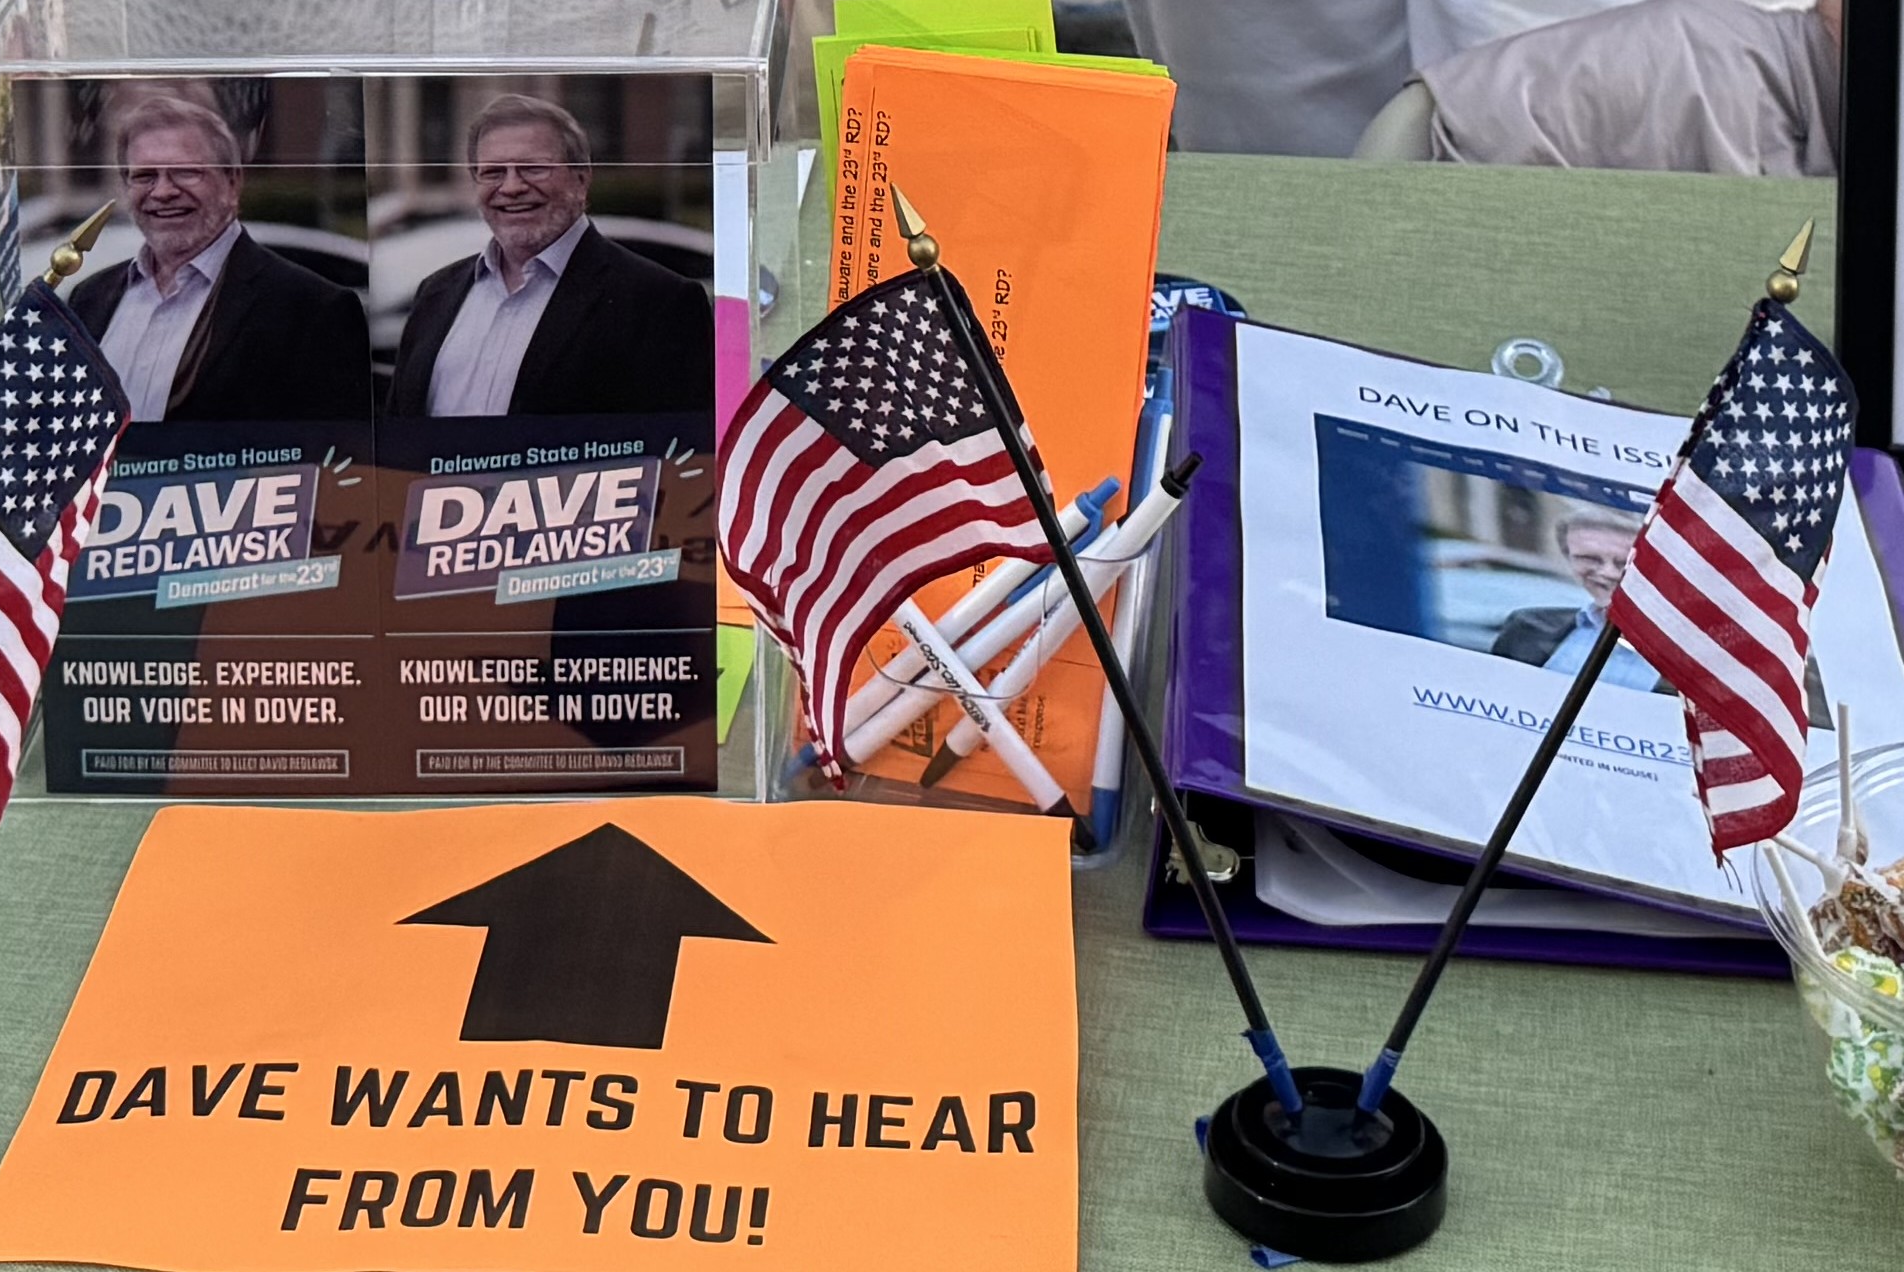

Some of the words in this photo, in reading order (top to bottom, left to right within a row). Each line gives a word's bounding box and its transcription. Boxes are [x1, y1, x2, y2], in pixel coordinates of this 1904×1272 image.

[846, 108, 863, 144] RD?
[843, 149, 859, 181] 23rd
[841, 185, 856, 213] the
[841, 215, 854, 248] and
[1359, 387, 1451, 422] DAVE
[1465, 408, 1519, 434] ON
[1530, 421, 1601, 456] THE
[84, 474, 301, 548] DAVE
[416, 467, 643, 545] DAVE
[87, 527, 293, 580] REDLAWSK
[427, 521, 633, 577] REDLAWSK
[63, 662, 208, 686] KNOWLEDGE.
[216, 662, 362, 686] EXPERIENCE.
[83, 697, 130, 724] OUR
[140, 698, 213, 724] VOICE
[222, 698, 245, 724] IN
[255, 698, 344, 724] DOVER.
[55, 1060, 302, 1127] DAVE
[329, 1066, 640, 1132] WANTS
[674, 1079, 774, 1146] TO
[807, 1089, 1038, 1156] HEAR
[280, 1168, 536, 1233] FROM
[571, 1170, 770, 1247] YOU!
